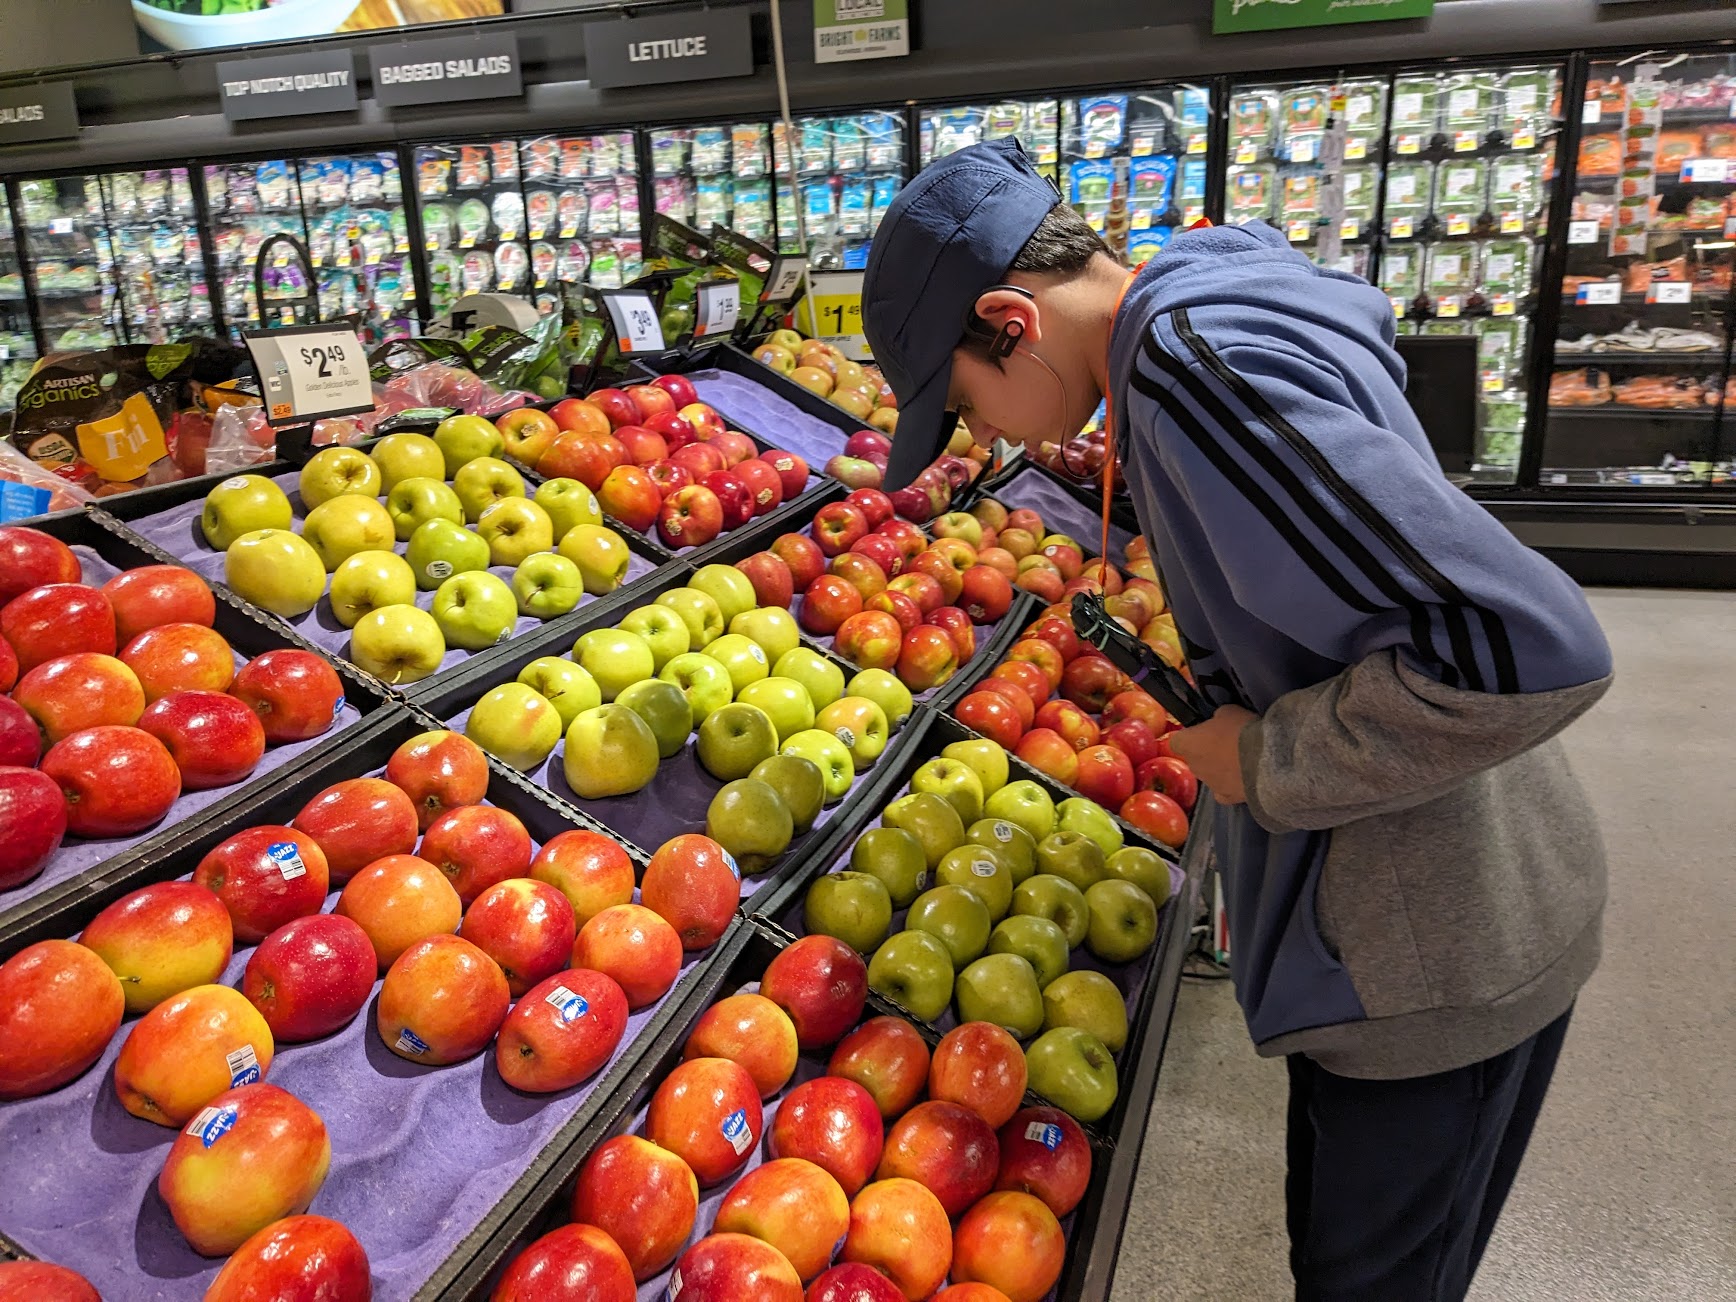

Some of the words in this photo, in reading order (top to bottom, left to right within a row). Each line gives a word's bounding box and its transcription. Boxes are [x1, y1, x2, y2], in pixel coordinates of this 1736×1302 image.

[820, 30, 853, 47] BRIGHT
[869, 26, 901, 42] FARMS
[628, 36, 707, 62] LETTUCE
[380, 62, 445, 84] BAGGED
[445, 56, 511, 79] SALADS
[223, 81, 250, 96] TOP
[250, 76, 294, 94] NOTCH
[294, 71, 349, 92] QUALITY
[43, 374, 95, 389] ARTISAN
[305, 383, 321, 392] Golden
[322, 381, 343, 390] Delicious
[273, 844, 295, 860] JAZZ
[206, 1112, 230, 1142] JAZZ
[726, 1112, 744, 1136] JAZZ
